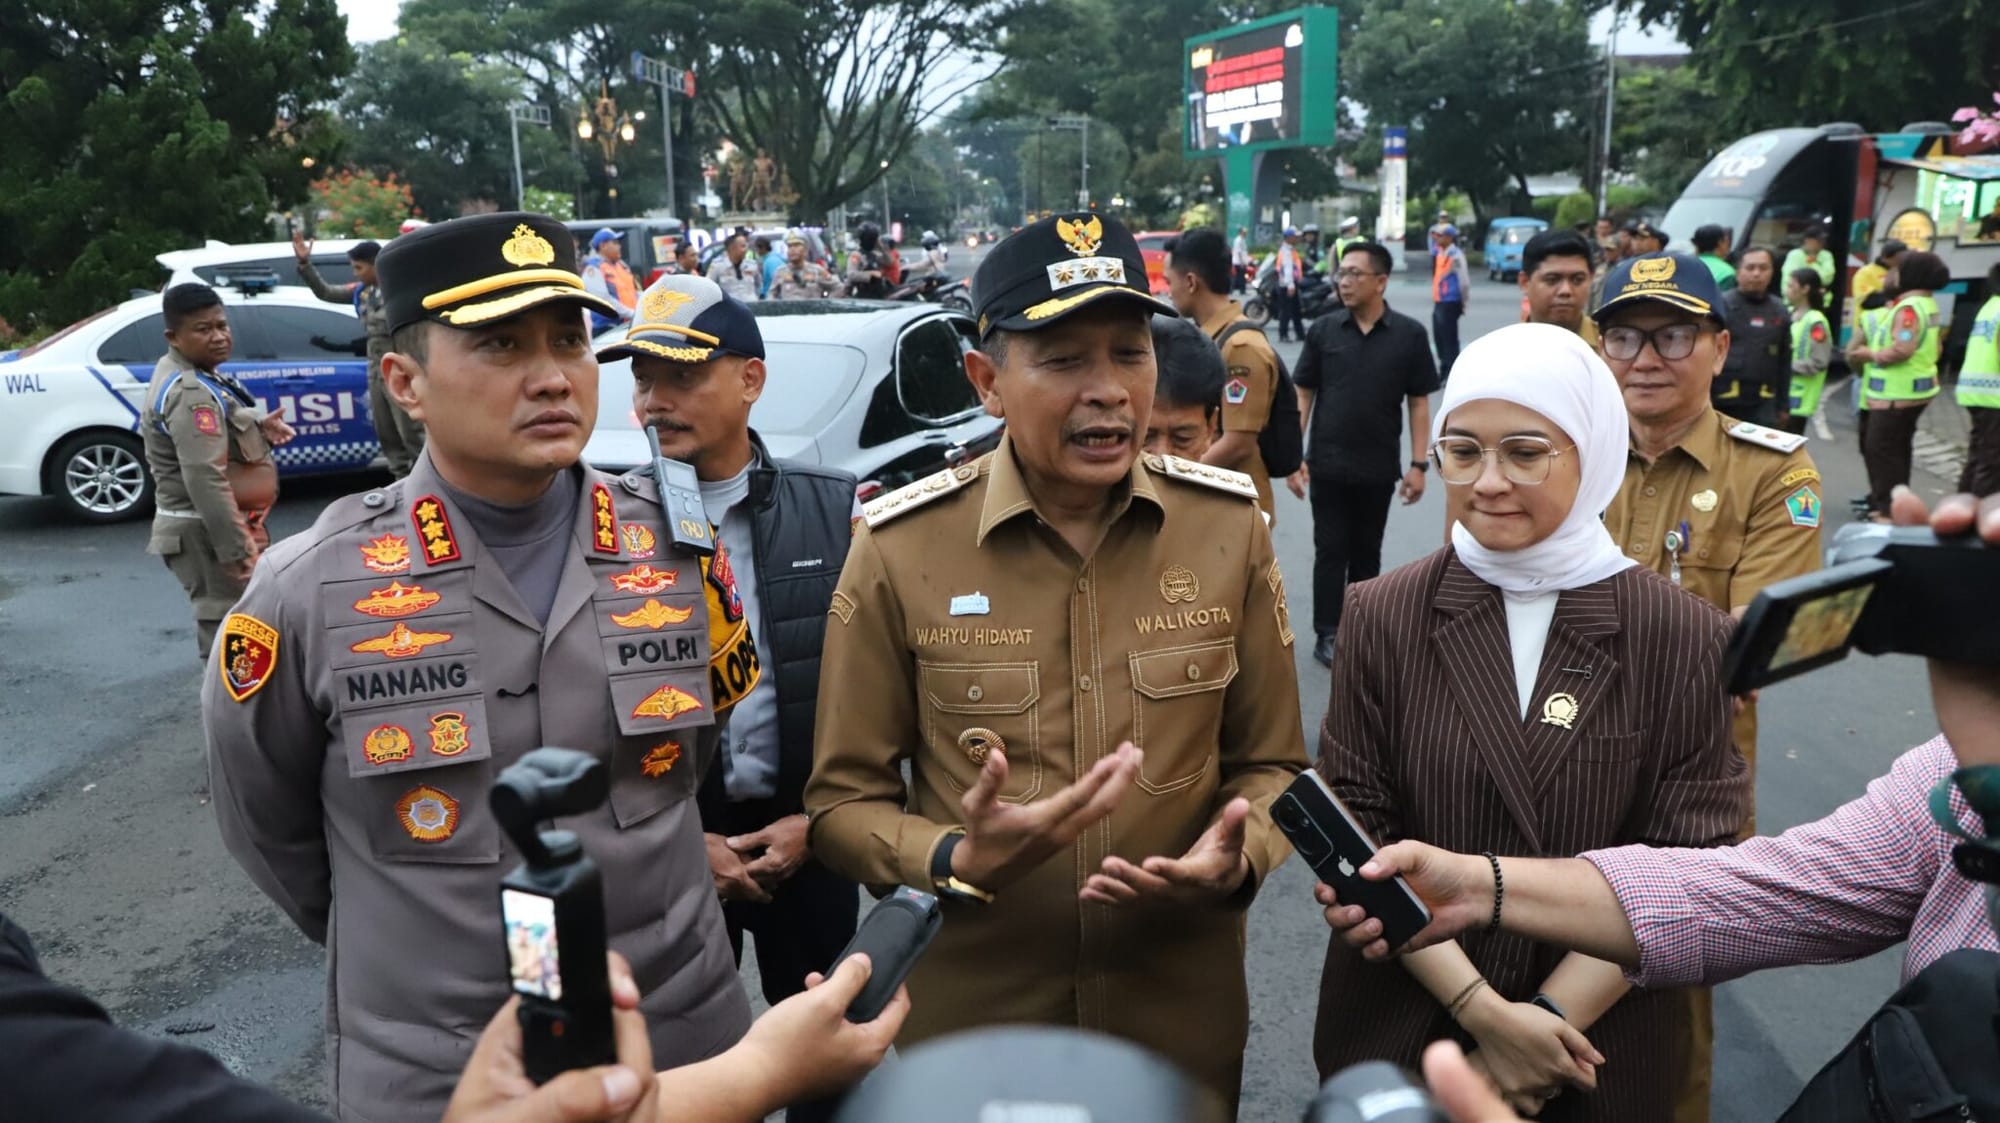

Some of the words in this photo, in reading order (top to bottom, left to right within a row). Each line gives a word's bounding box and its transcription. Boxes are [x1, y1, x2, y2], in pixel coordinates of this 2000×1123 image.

[1709, 155, 1767, 177] TOP
[5, 373, 47, 394] WAL
[1135, 607, 1231, 634] WALIKOTA
[916, 627, 969, 646] WAHYU
[975, 628, 1033, 646] HIDAYAT
[618, 636, 698, 666] POLRI
[347, 663, 467, 701] NANANG
